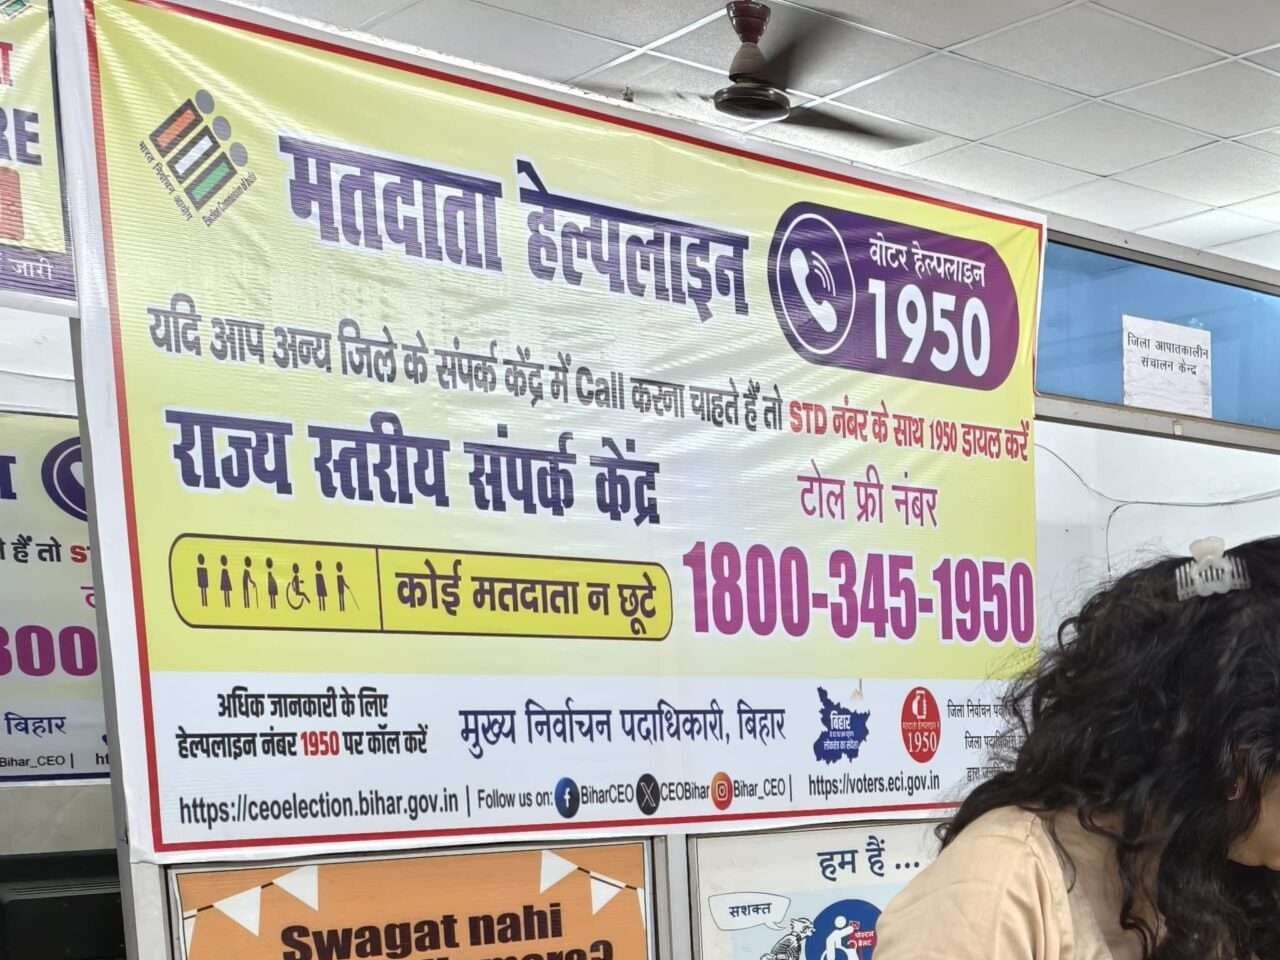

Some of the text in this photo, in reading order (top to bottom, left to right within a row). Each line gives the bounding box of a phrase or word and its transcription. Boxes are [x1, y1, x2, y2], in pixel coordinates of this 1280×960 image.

[278, 135, 749, 320] मतदाता हेल्पलाइन
[11, 257, 53, 281] जारी
[869, 237, 986, 288] वोटर हेल्पलाइन
[868, 279, 990, 377] 1950
[1127, 331, 1209, 360] जिला आपातकालीन
[147, 293, 1030, 461] यदि आप अन्य जिले के संपर्क केंद्र में Call करना चाहते हैं तो STD नंबर के साथ 1950 डायल करें
[1141, 354, 1174, 372] संचालन
[165, 410, 661, 527] राज्य स्तरीय संपर्क केंद्र
[797, 459, 938, 527] टोल फ्री नंबर
[14, 535, 62, 563] हैं तो
[395, 559, 657, 636] कोई मतदाता न छूटे
[682, 541, 1035, 643] 1800-345-1950
[217, 686, 389, 718] अधिक जानकारी के लिए
[947, 699, 965, 718] जिला
[967, 698, 992, 718] निर्वाचन
[4, 712, 66, 738] बिहार
[458, 697, 786, 759] मुख्य निर्वाचन पदाधिकारी, बिहार
[830, 710, 851, 729] बिहार
[176, 723, 429, 760] हेल्पलाइन नंबर 1950 पर कॉल करें
[908, 731, 937, 753] 1950
[965, 730, 981, 750] जिला
[477, 777, 786, 809] Follow us on: BiharCEO CEOBihar Bihar_CEO
[808, 769, 940, 800] https://voters.eci.gov.in
[178, 786, 459, 829] https://ceoelection.bihar.gov.in
[817, 849, 859, 881] हम
[865, 836, 886, 877] हैं
[468, 902, 563, 948] nahi
[728, 903, 772, 919] सशक्त
